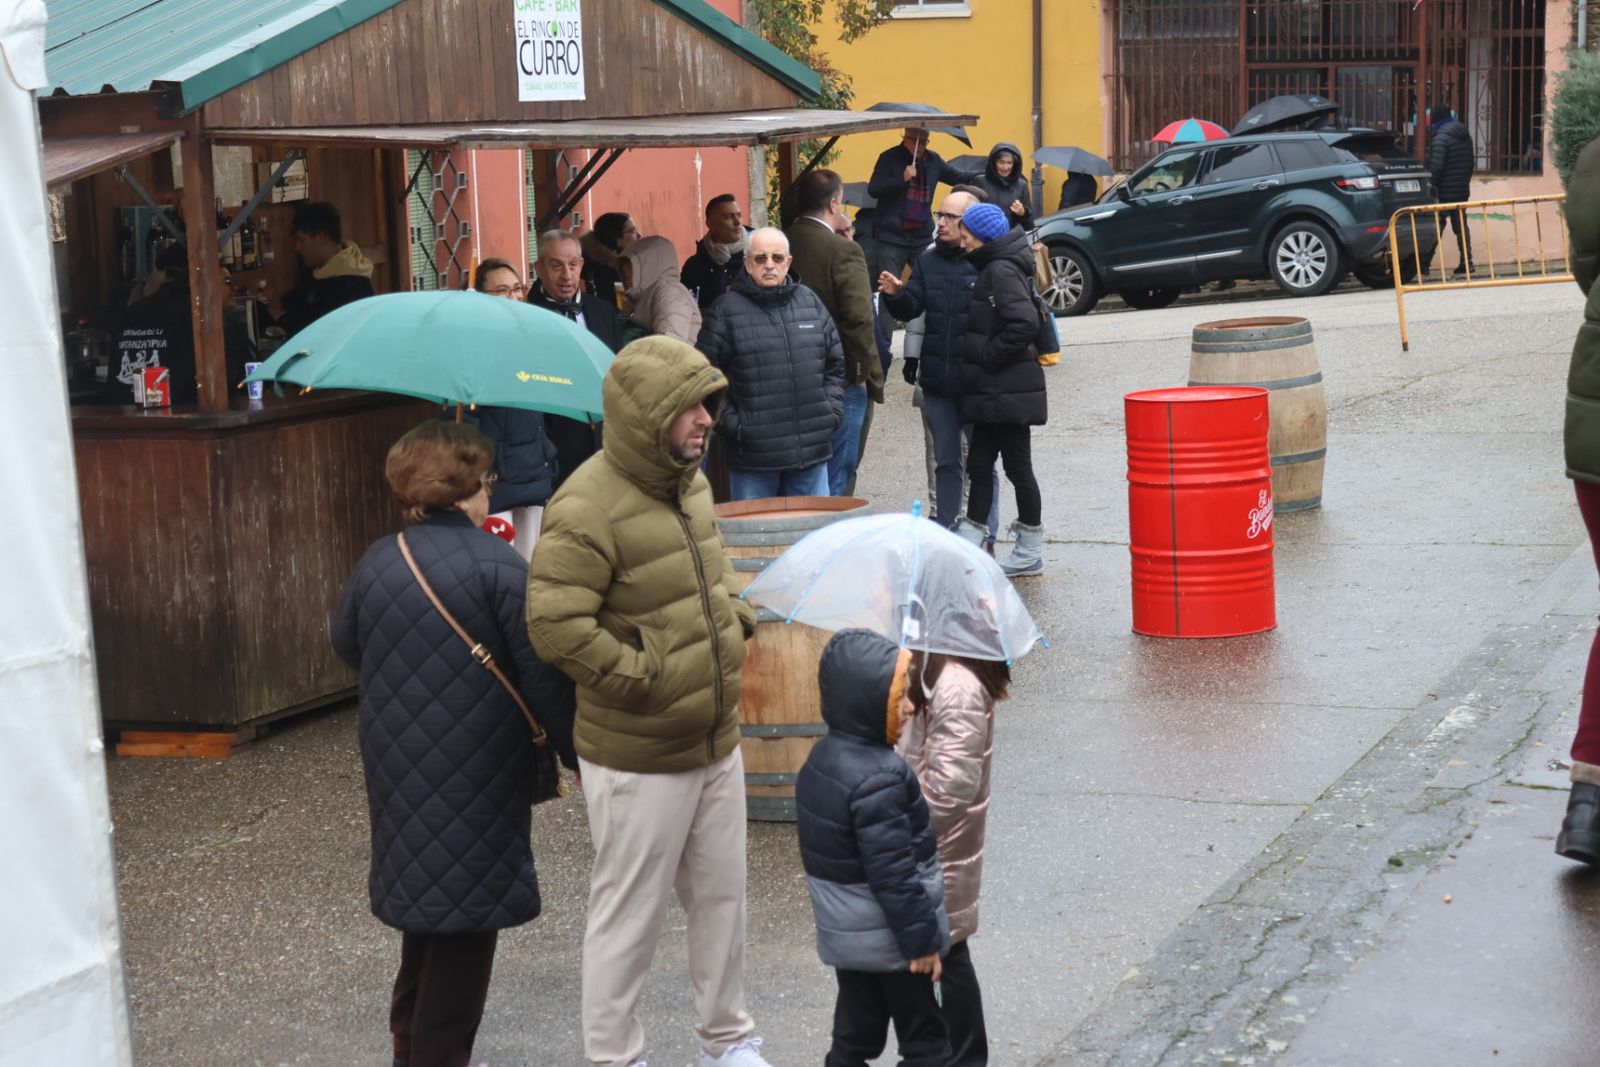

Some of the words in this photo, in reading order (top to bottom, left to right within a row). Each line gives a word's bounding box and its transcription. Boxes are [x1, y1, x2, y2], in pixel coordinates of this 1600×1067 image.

[555, 0, 577, 12] BAR
[518, 20, 529, 38] EL
[567, 21, 579, 38] DE
[519, 39, 580, 76] CURRO
